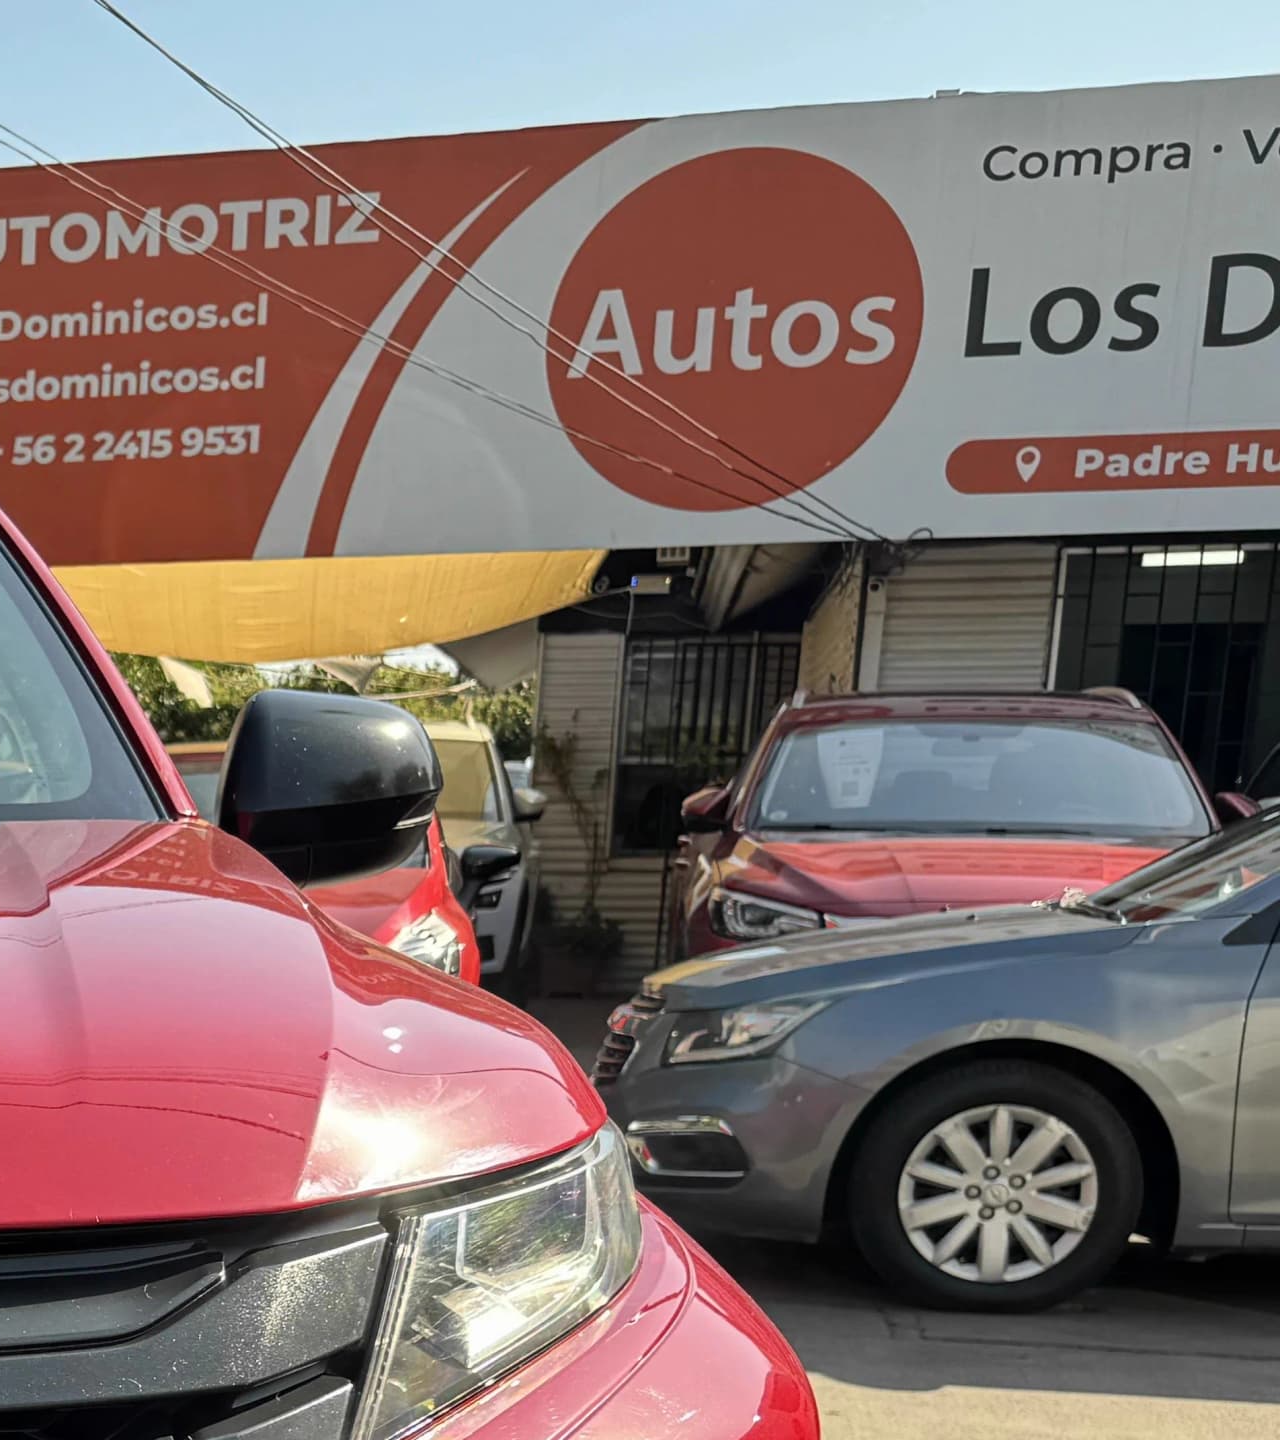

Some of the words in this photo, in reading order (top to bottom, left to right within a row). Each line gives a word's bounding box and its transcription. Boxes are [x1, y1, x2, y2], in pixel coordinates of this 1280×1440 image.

[983, 141, 1192, 184] Compra
[1243, 127, 1280, 165] V
[566, 287, 897, 379] Autos
[964, 267, 1161, 358] Los
[11, 434, 56, 466] 56
[62, 432, 86, 463] 2
[92, 428, 171, 461] 2415
[180, 424, 261, 458] 9531
[1074, 444, 1211, 479] Padre
